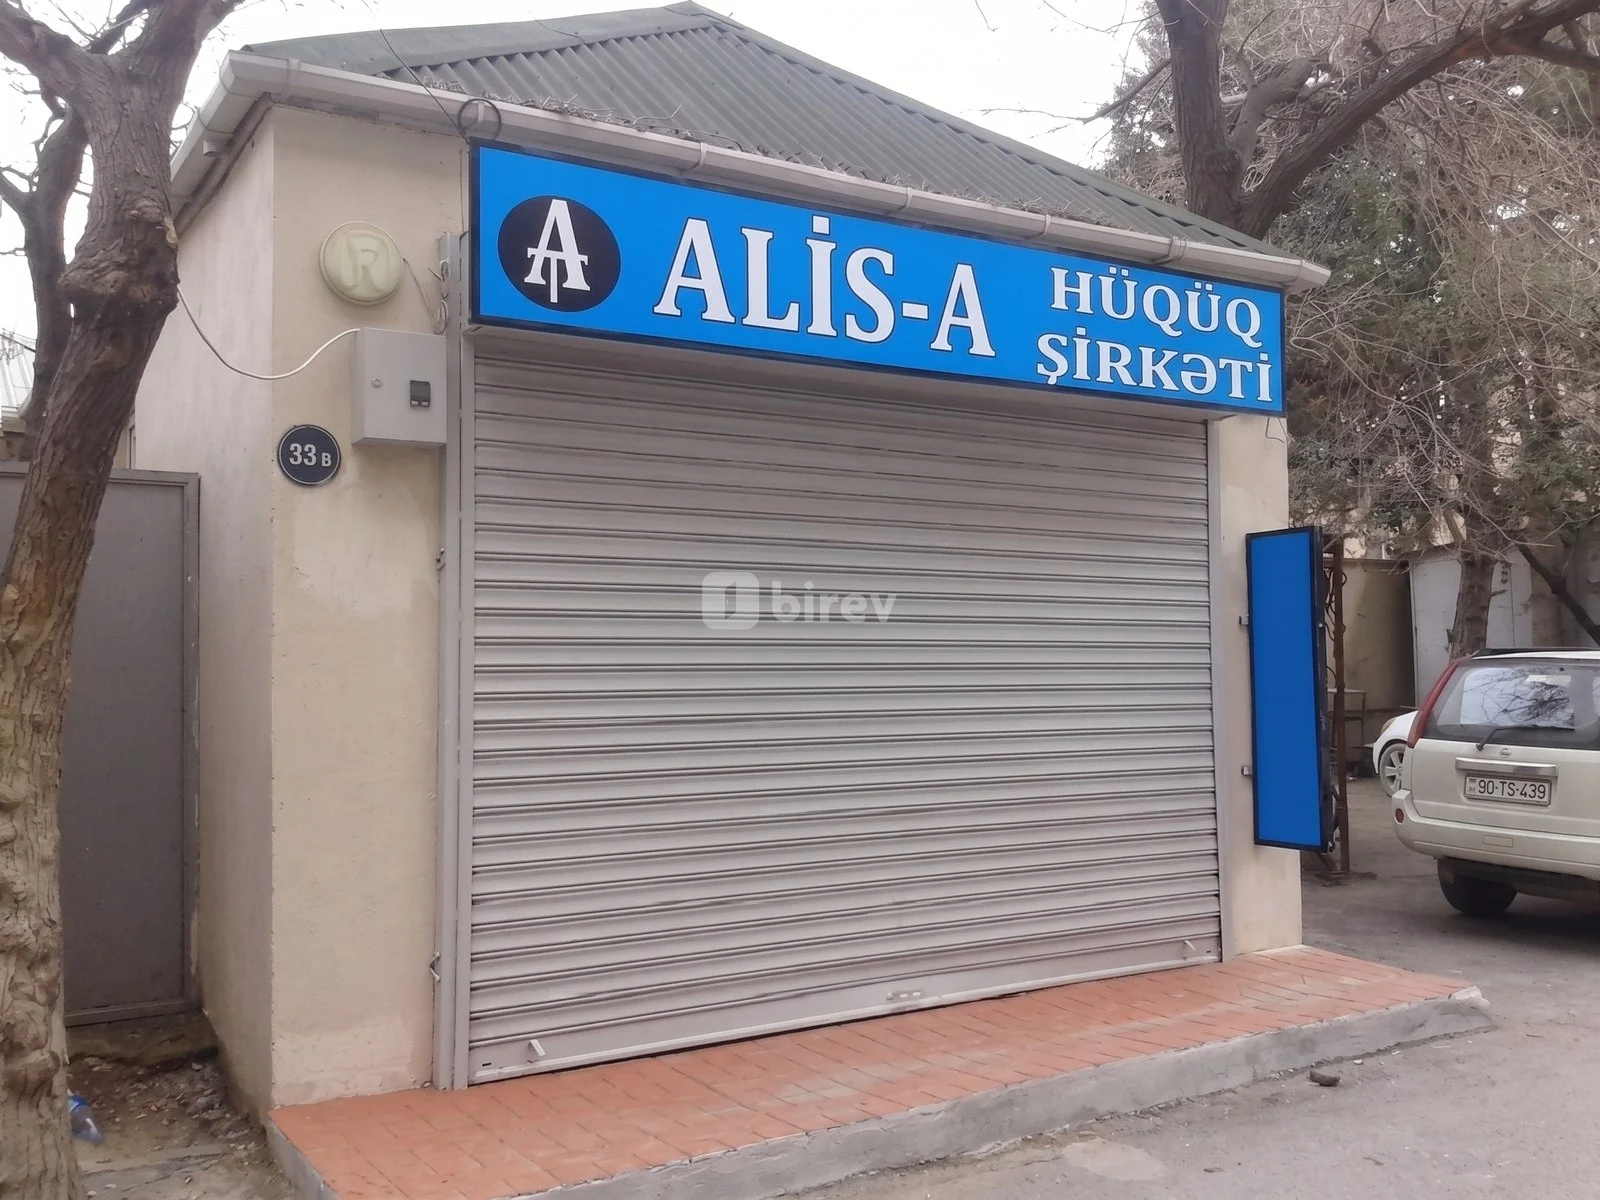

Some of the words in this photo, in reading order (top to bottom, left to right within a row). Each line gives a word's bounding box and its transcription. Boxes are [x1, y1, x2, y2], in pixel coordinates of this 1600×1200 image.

[652, 214, 996, 357] ALİS-A
[1050, 266, 1263, 348] HÜQÜQ
[1037, 327, 1272, 402] ŞİRKƏTİ
[289, 443, 317, 466] 33
